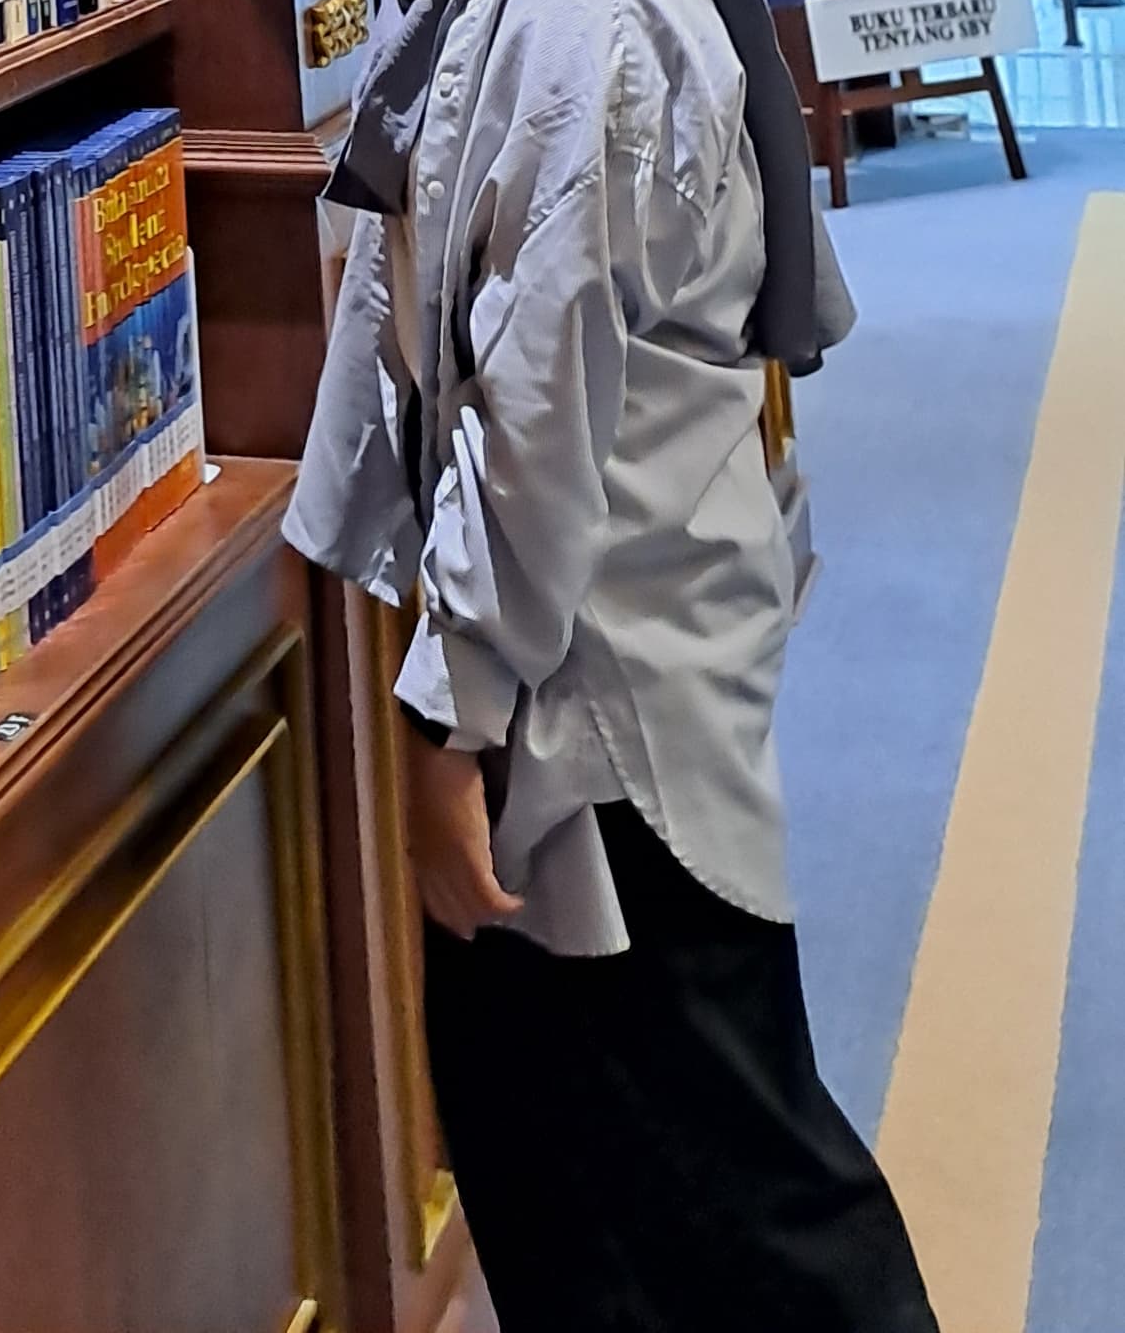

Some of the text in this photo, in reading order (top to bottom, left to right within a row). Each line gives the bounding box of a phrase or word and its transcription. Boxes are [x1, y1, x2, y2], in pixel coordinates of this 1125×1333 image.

[850, 8, 904, 33] BUKU
[861, 17, 992, 53] TENTANG SBY
